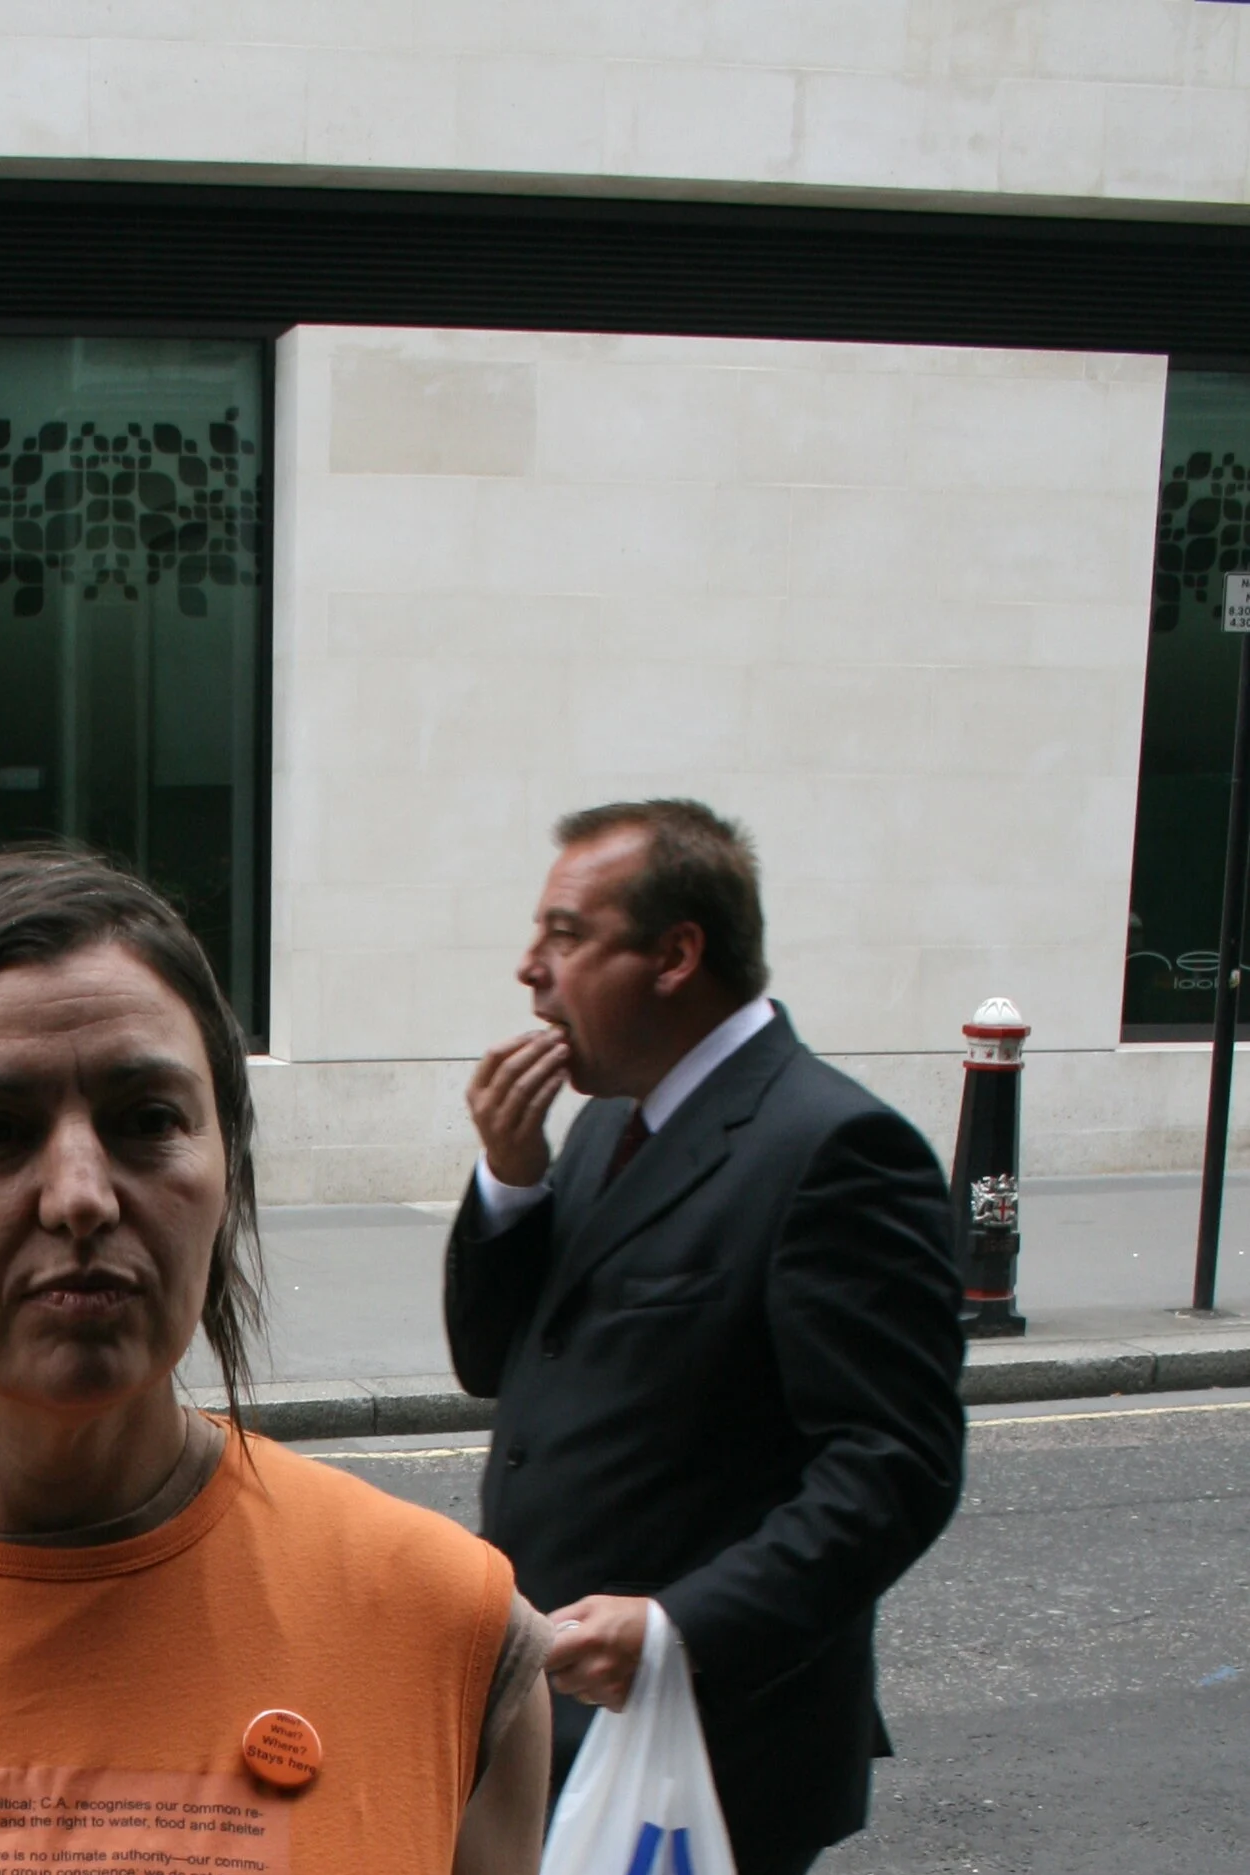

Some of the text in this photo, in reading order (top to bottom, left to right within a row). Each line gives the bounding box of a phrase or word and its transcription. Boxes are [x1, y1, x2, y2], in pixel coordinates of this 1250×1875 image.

[271, 1724, 303, 1740] What?
[262, 1735, 307, 1755] Where?
[247, 1745, 316, 1776] Stays here
[75, 1798, 151, 1813] recognises
[156, 1801, 177, 1810] our
[183, 1802, 241, 1815] common
[0, 1814, 26, 1826] and
[30, 1814, 51, 1826] the
[57, 1814, 87, 1829] right
[91, 1815, 105, 1826] to
[155, 1815, 185, 1828] food
[190, 1818, 216, 1830] and
[220, 1820, 265, 1835] shelter
[14, 1848, 25, 1860] is
[30, 1851, 48, 1860] no
[52, 1849, 107, 1861] ultimate
